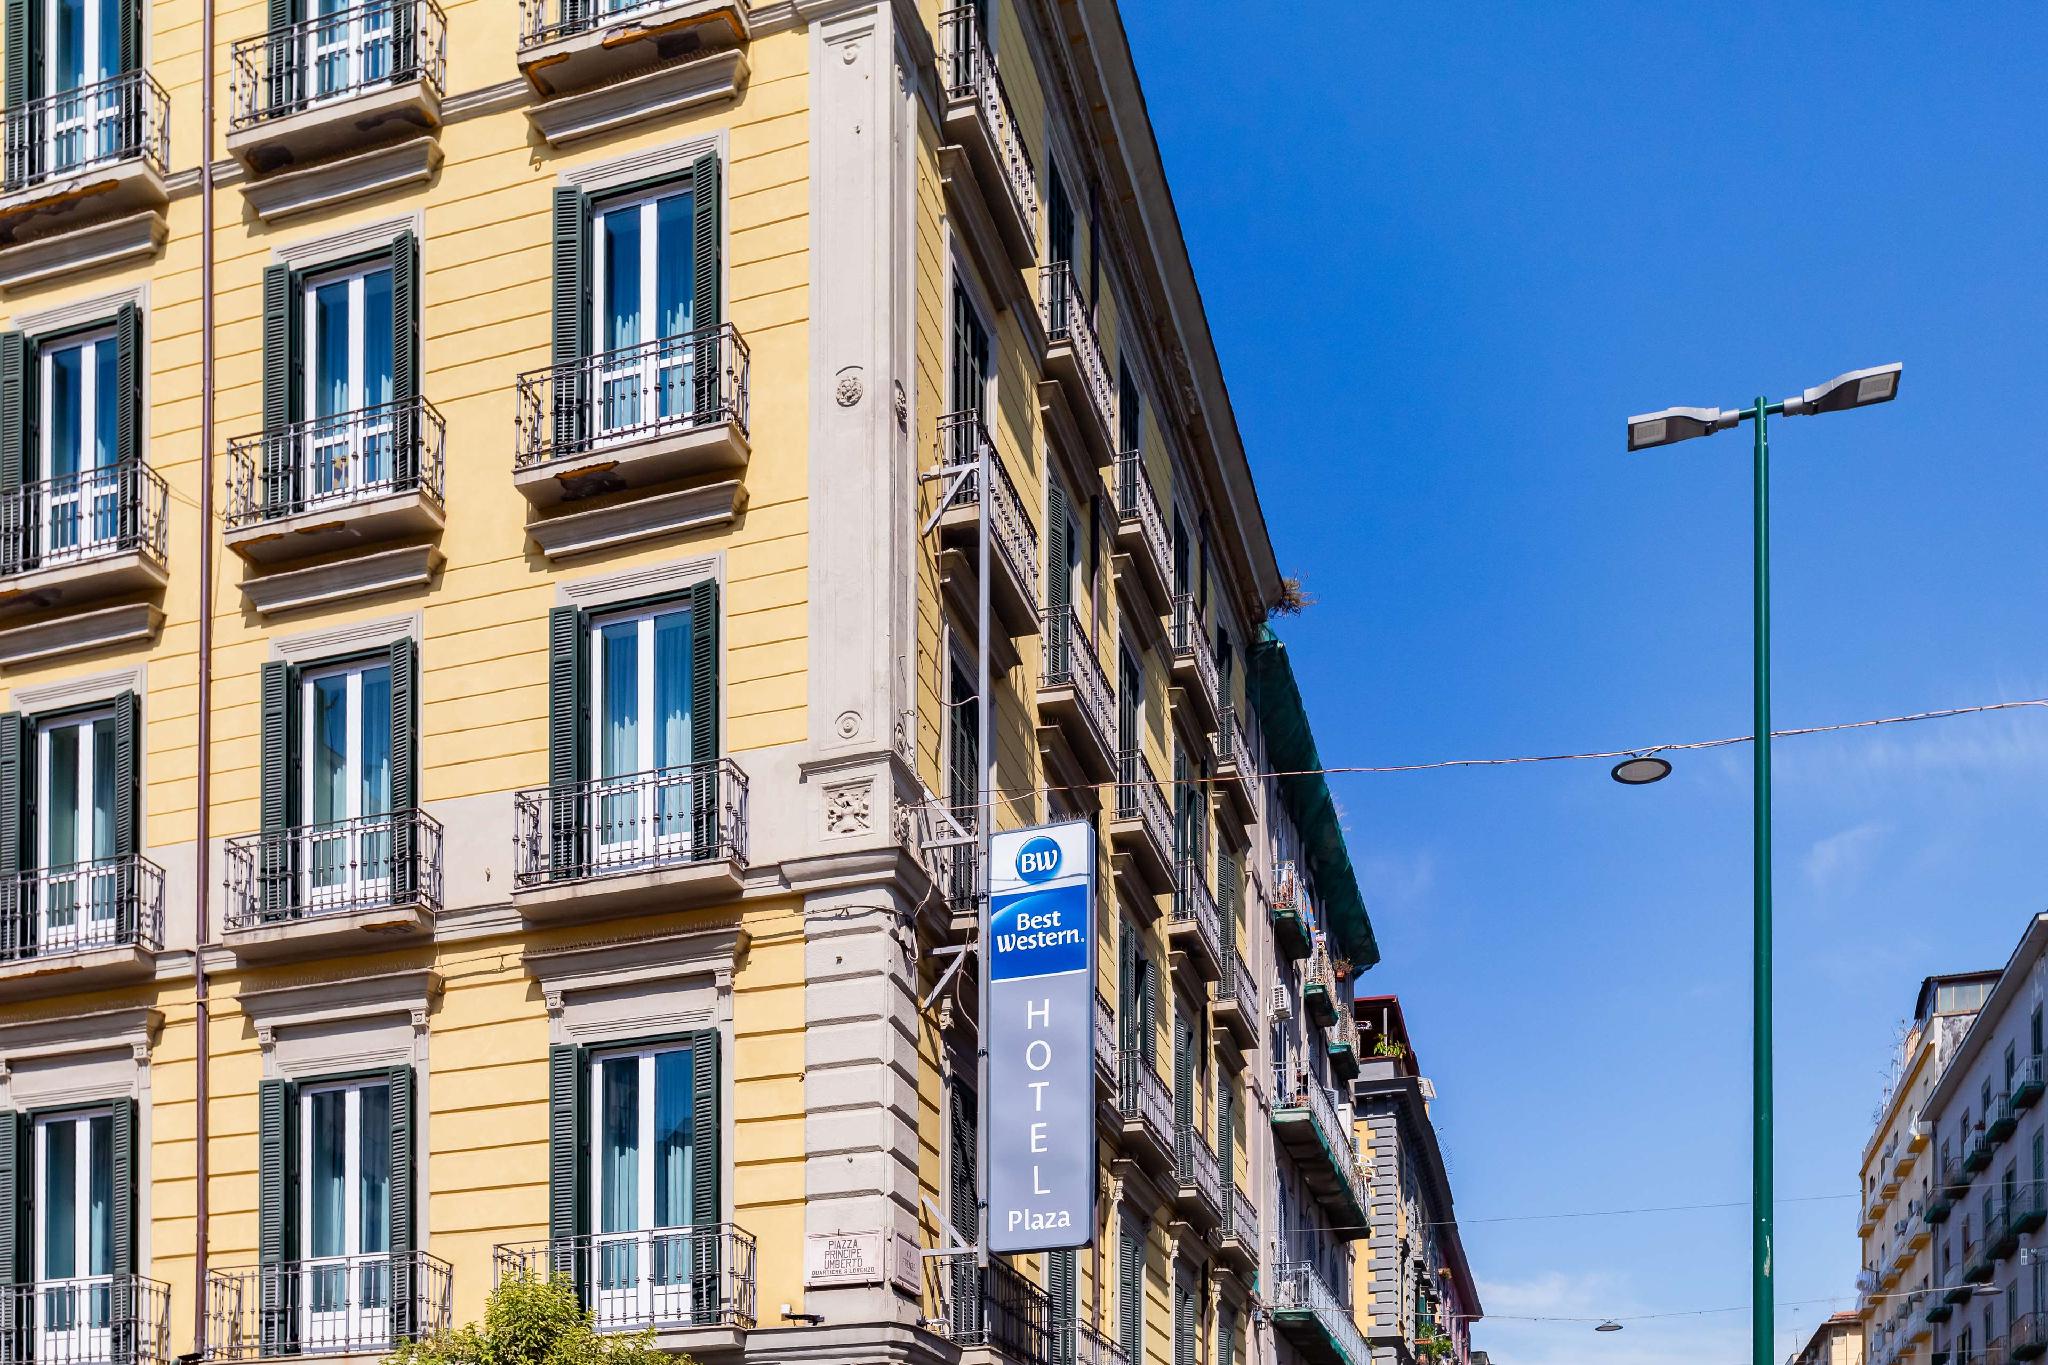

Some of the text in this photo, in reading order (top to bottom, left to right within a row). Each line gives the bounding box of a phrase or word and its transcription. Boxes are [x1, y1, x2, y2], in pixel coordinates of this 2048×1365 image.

[1021, 849, 1058, 873] BW
[1017, 910, 1062, 931] Best
[1025, 998, 1051, 1195] HOTEL
[1008, 1208, 1072, 1232] Plaza
[824, 1249, 862, 1260] PRINCIPE
[828, 1239, 858, 1250] PIAZZA
[824, 1258, 863, 1270] UMBERTO
